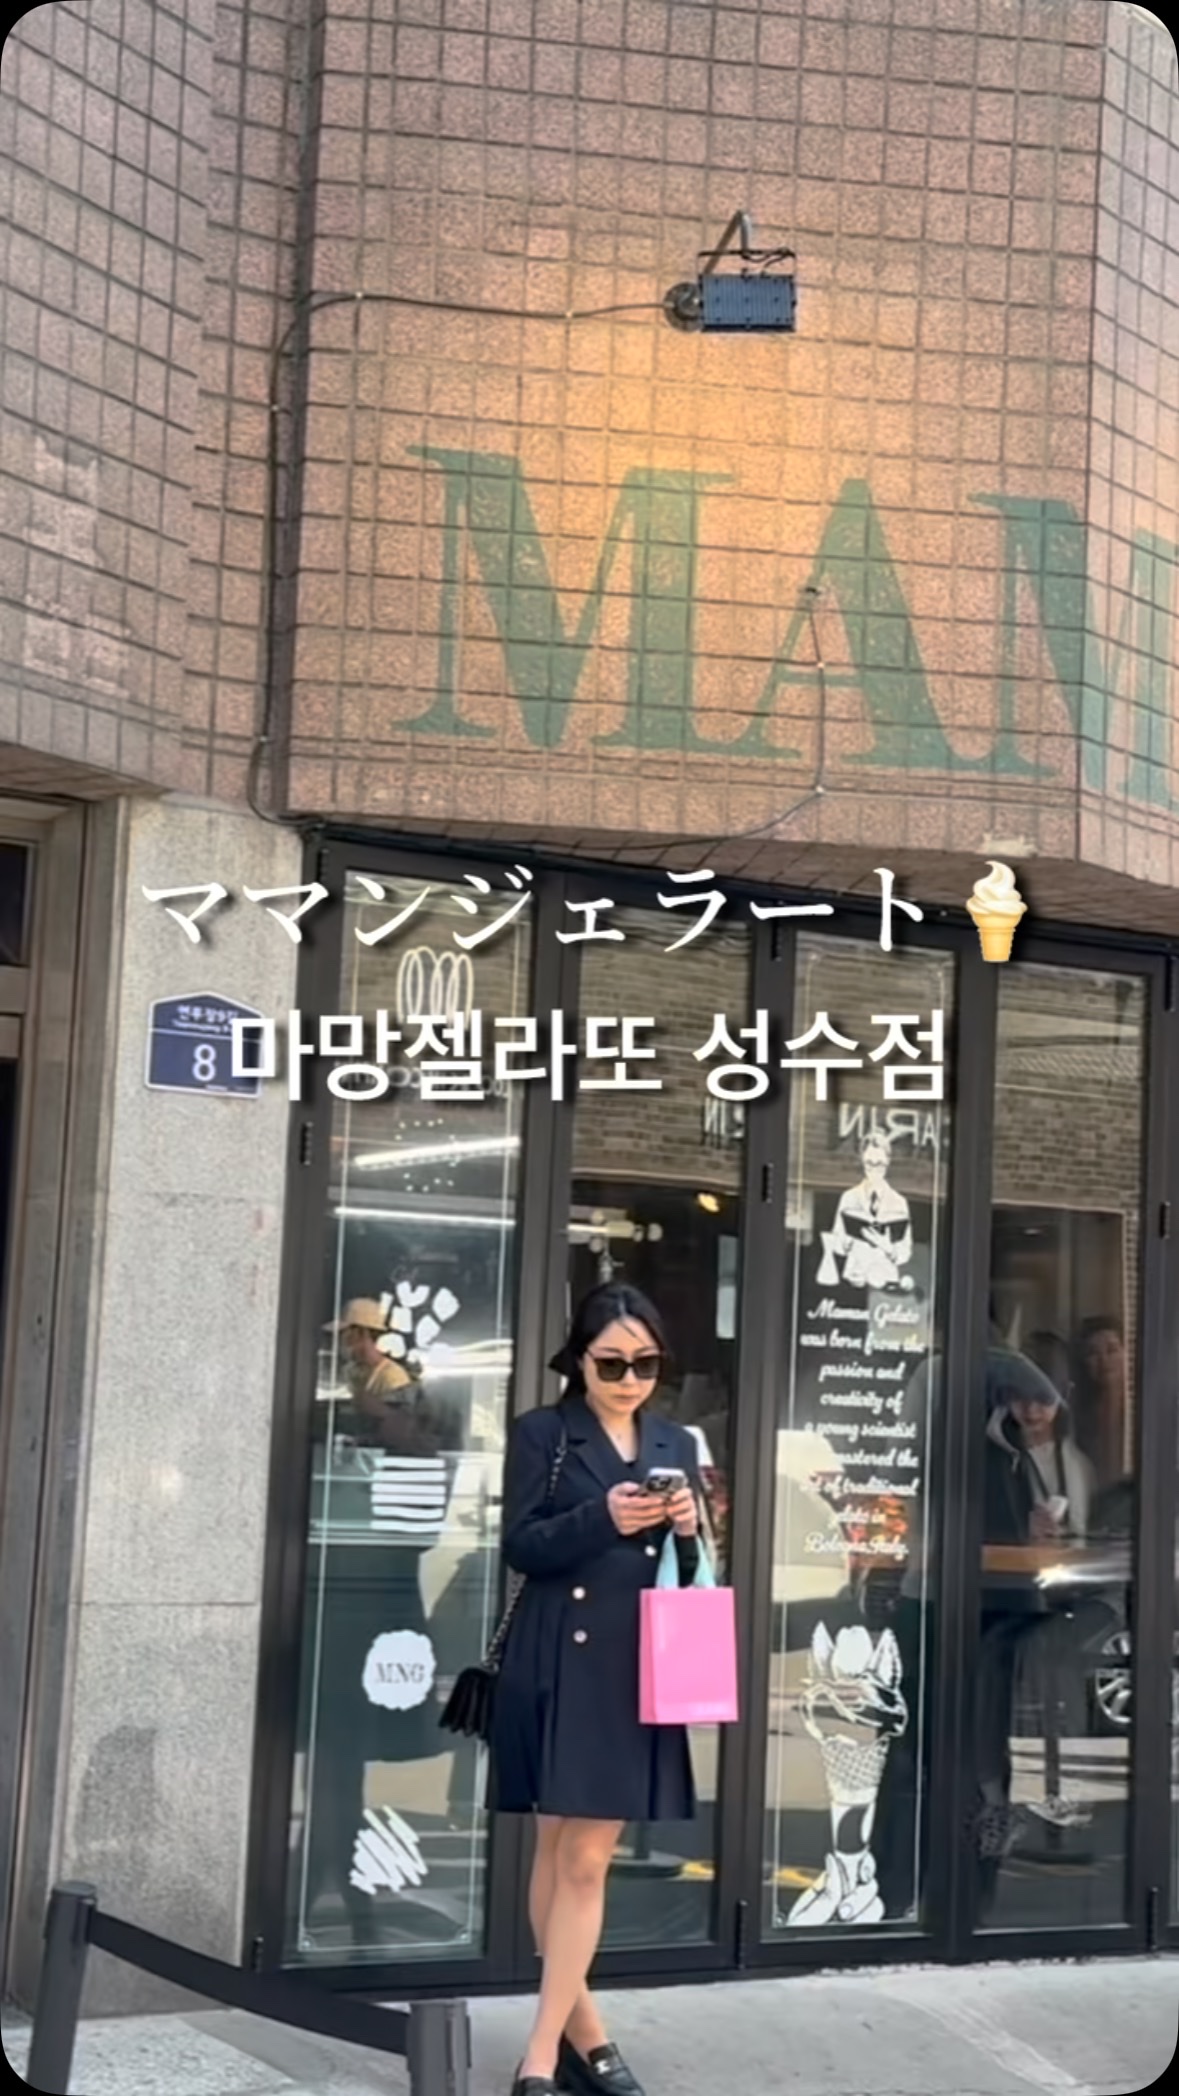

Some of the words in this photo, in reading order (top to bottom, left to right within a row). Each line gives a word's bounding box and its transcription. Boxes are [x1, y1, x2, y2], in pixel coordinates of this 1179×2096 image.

[192, 1043, 217, 1082] 8
[829, 1328, 862, 1349] born
[818, 1361, 874, 1382] passion
[876, 1361, 906, 1381] and
[897, 1448, 920, 1468] the
[375, 1662, 425, 1684] MNG
